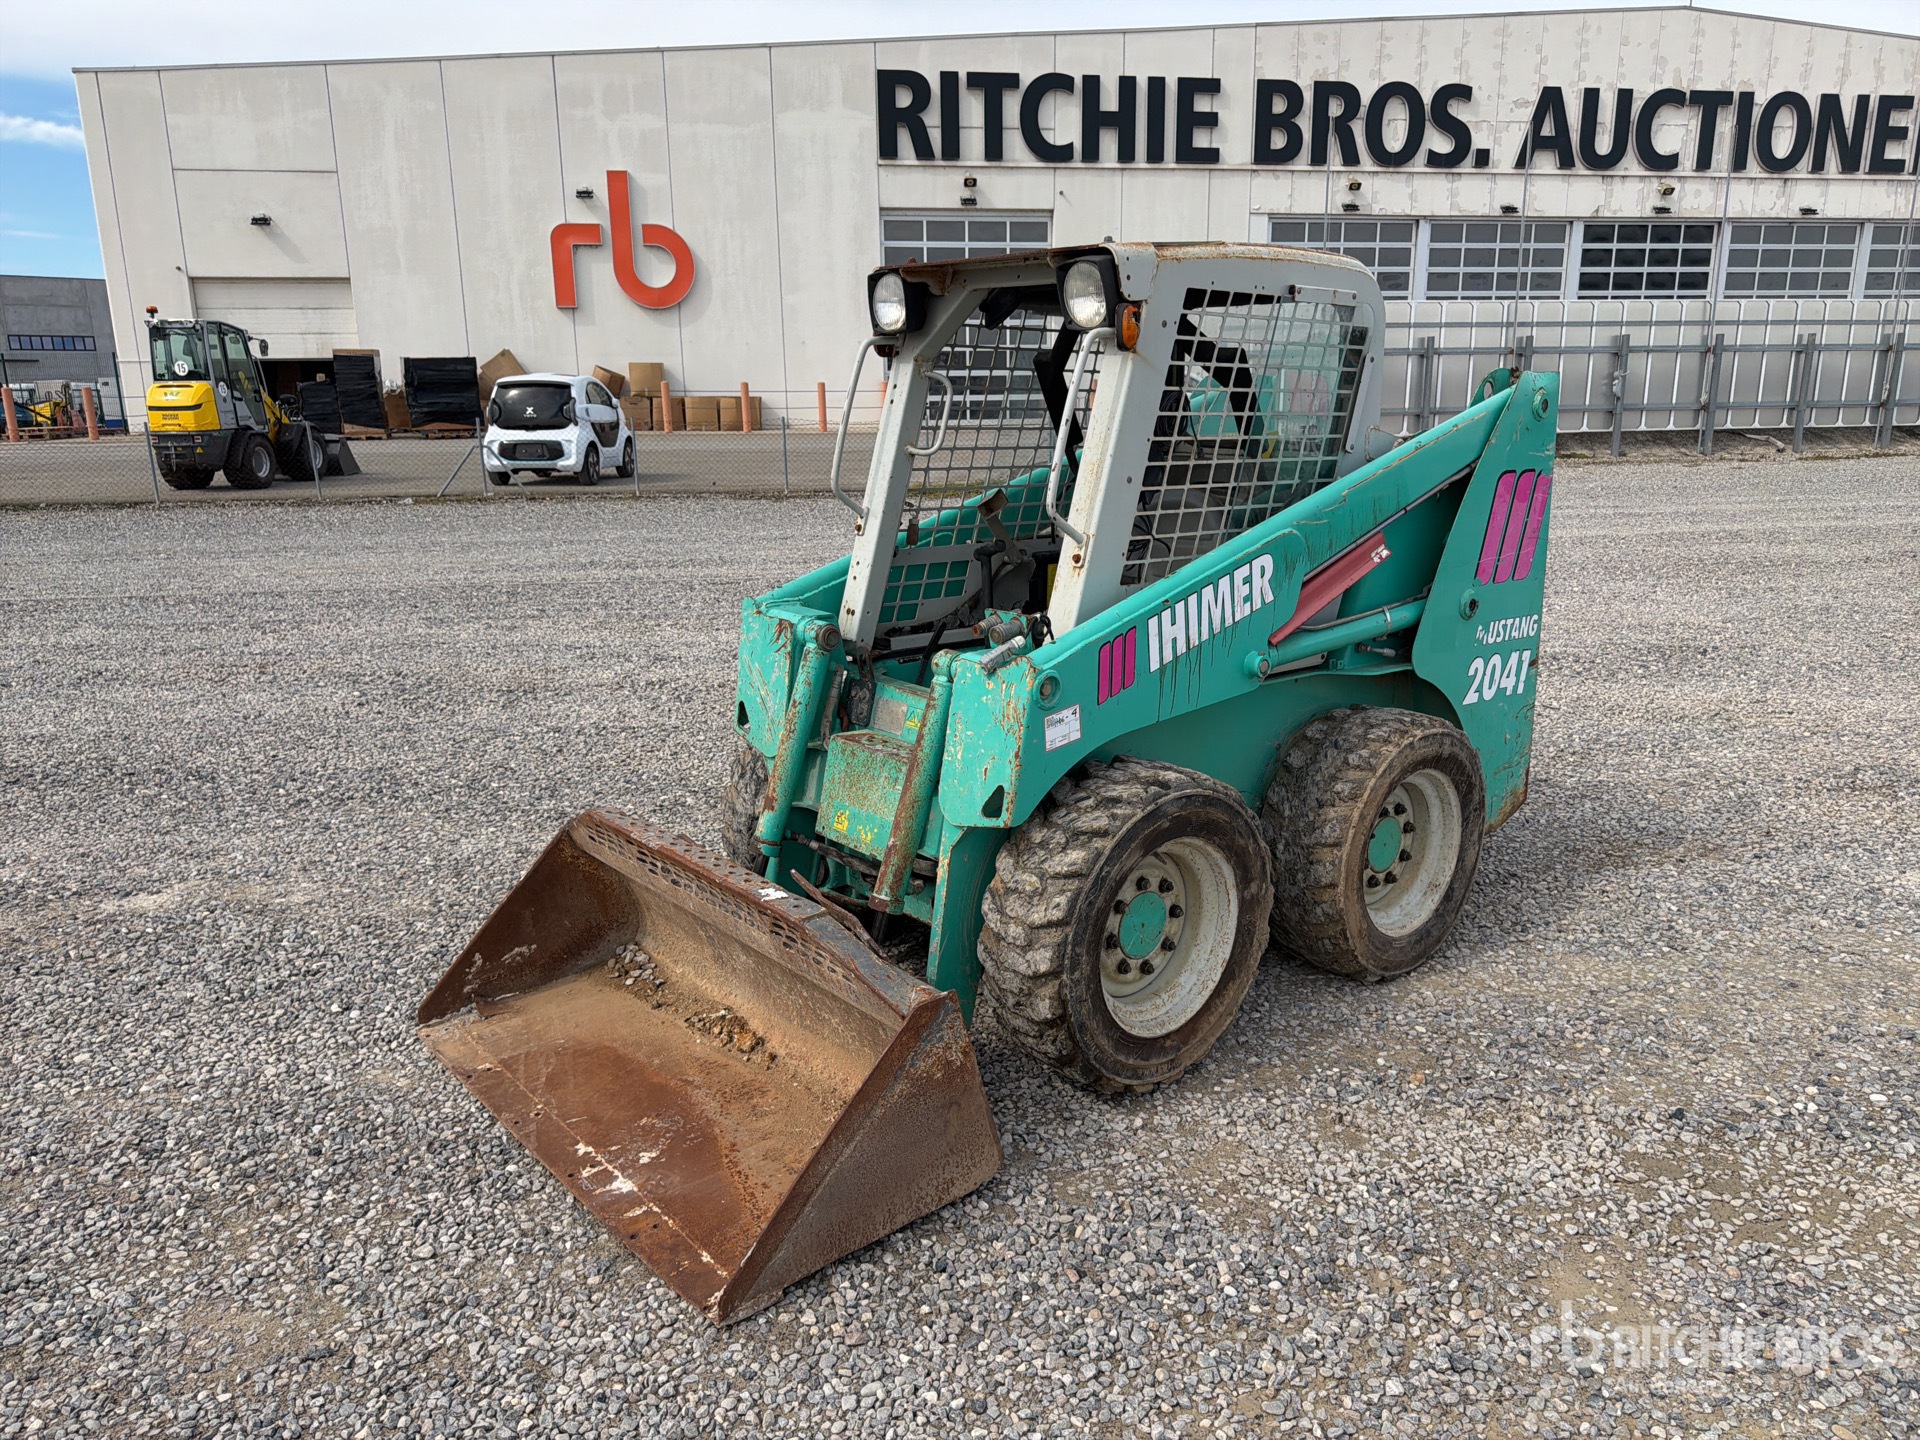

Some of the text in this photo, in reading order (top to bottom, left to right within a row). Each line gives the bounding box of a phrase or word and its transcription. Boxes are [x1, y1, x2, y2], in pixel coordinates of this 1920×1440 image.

[876, 69, 1920, 175] RITCHIE BROS. AUCTIONE
[550, 170, 696, 310] rb
[177, 363, 186, 373] 15
[1147, 553, 1275, 673] IHIMER
[1462, 649, 1531, 706] 2041
